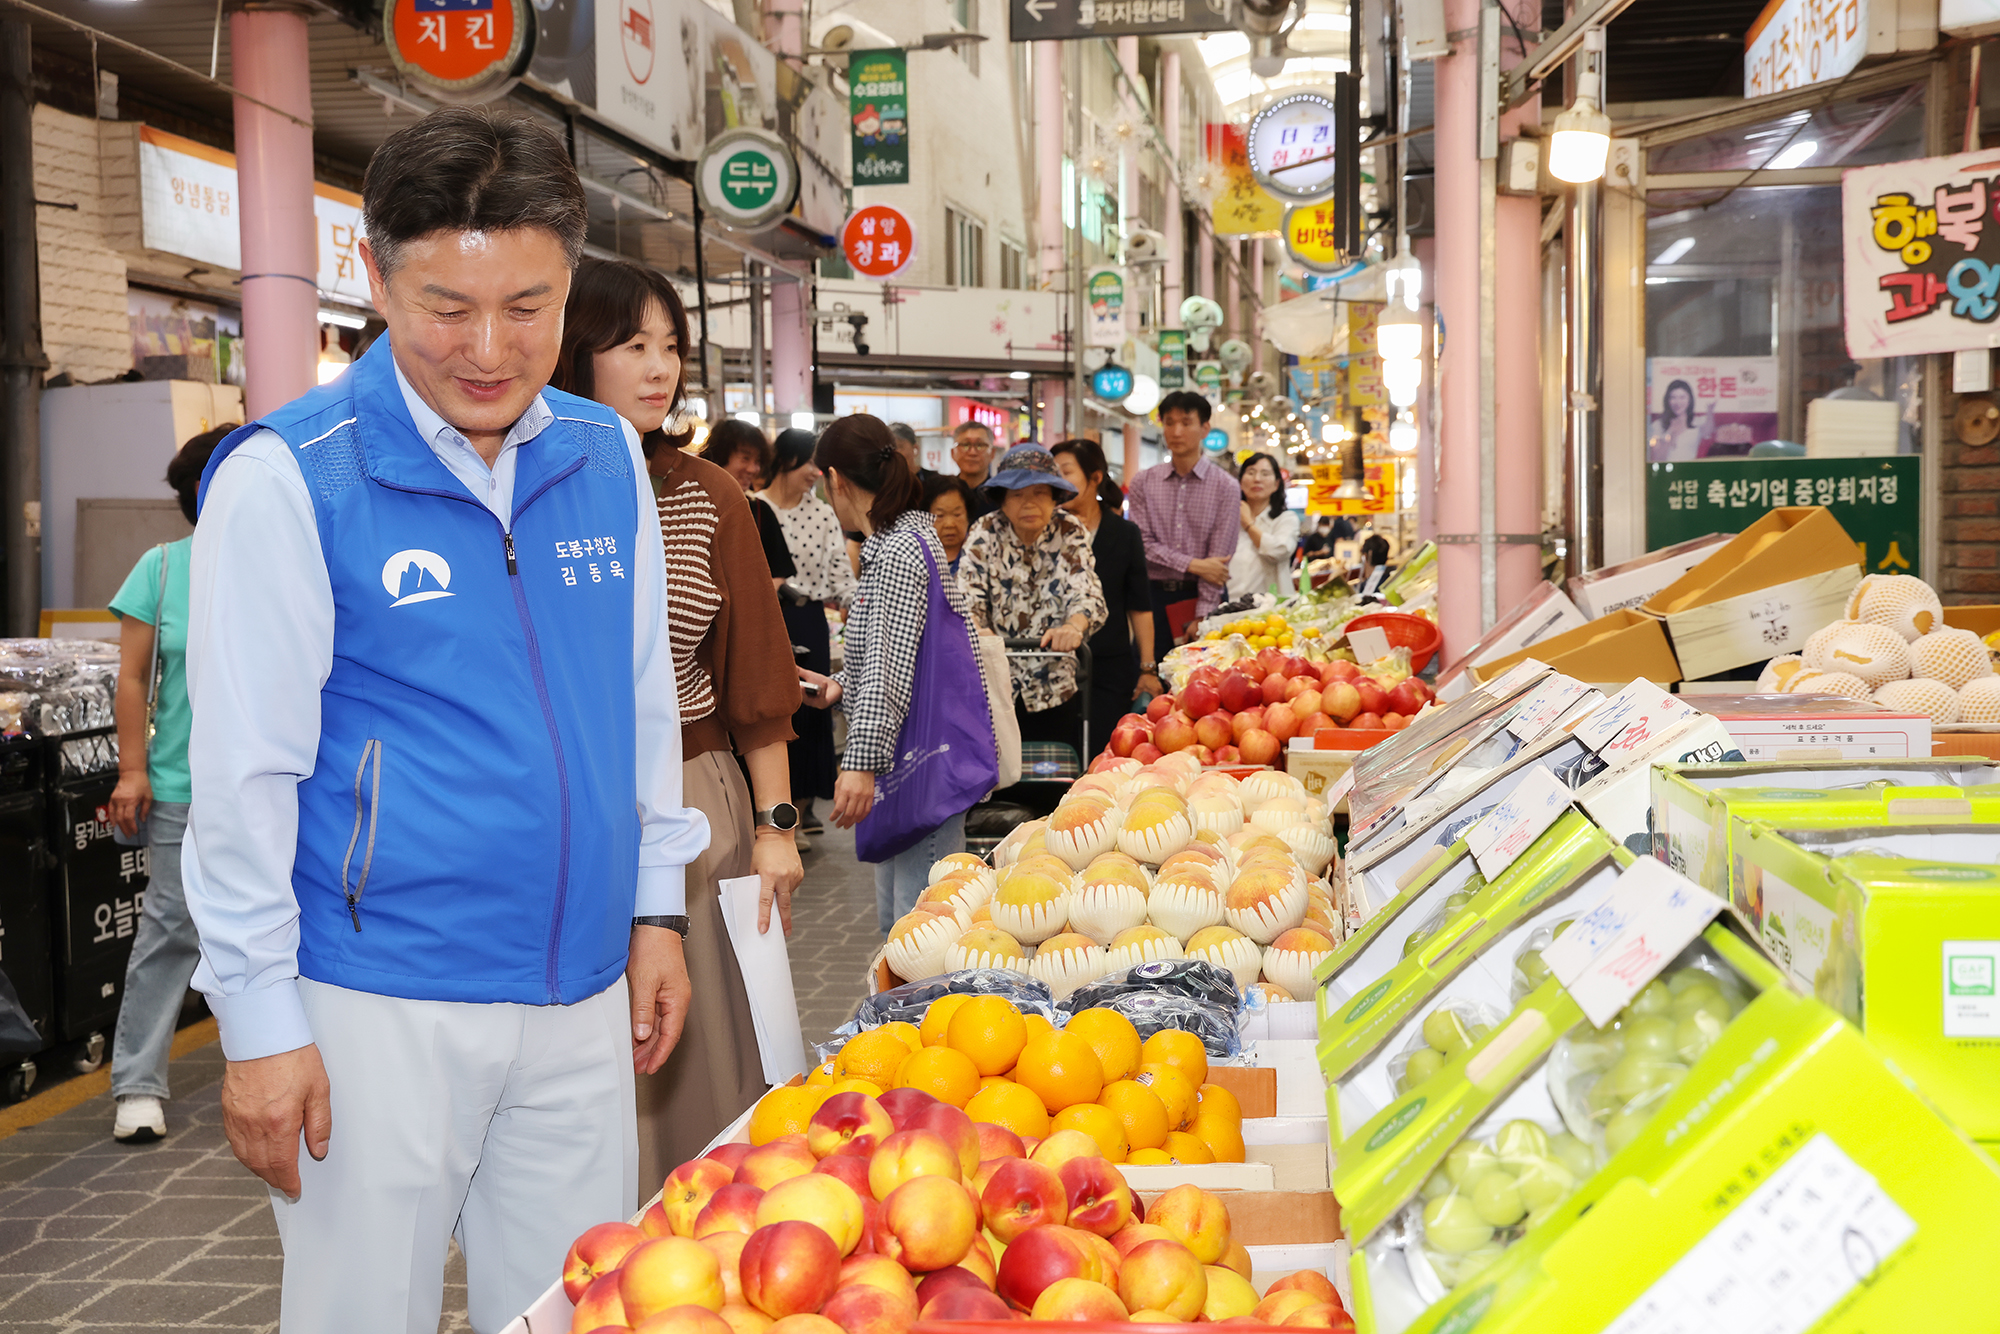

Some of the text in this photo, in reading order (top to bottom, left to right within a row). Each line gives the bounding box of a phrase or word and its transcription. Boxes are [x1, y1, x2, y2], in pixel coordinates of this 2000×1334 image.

[417, 13, 495, 52] 치킨
[727, 161, 774, 195] 두부
[171, 176, 230, 216] 양념통닭
[860, 216, 896, 236] 삼양
[1872, 178, 2000, 266] 행복
[853, 240, 902, 267] 청과
[1697, 376, 1738, 398] 한돈
[1668, 480, 1699, 494] 사단
[1707, 475, 1898, 508] 축산기업 중앙회지정
[1668, 495, 1699, 509] 법인
[555, 536, 617, 559] 도봉구청장
[561, 560, 625, 586] 김동욱
